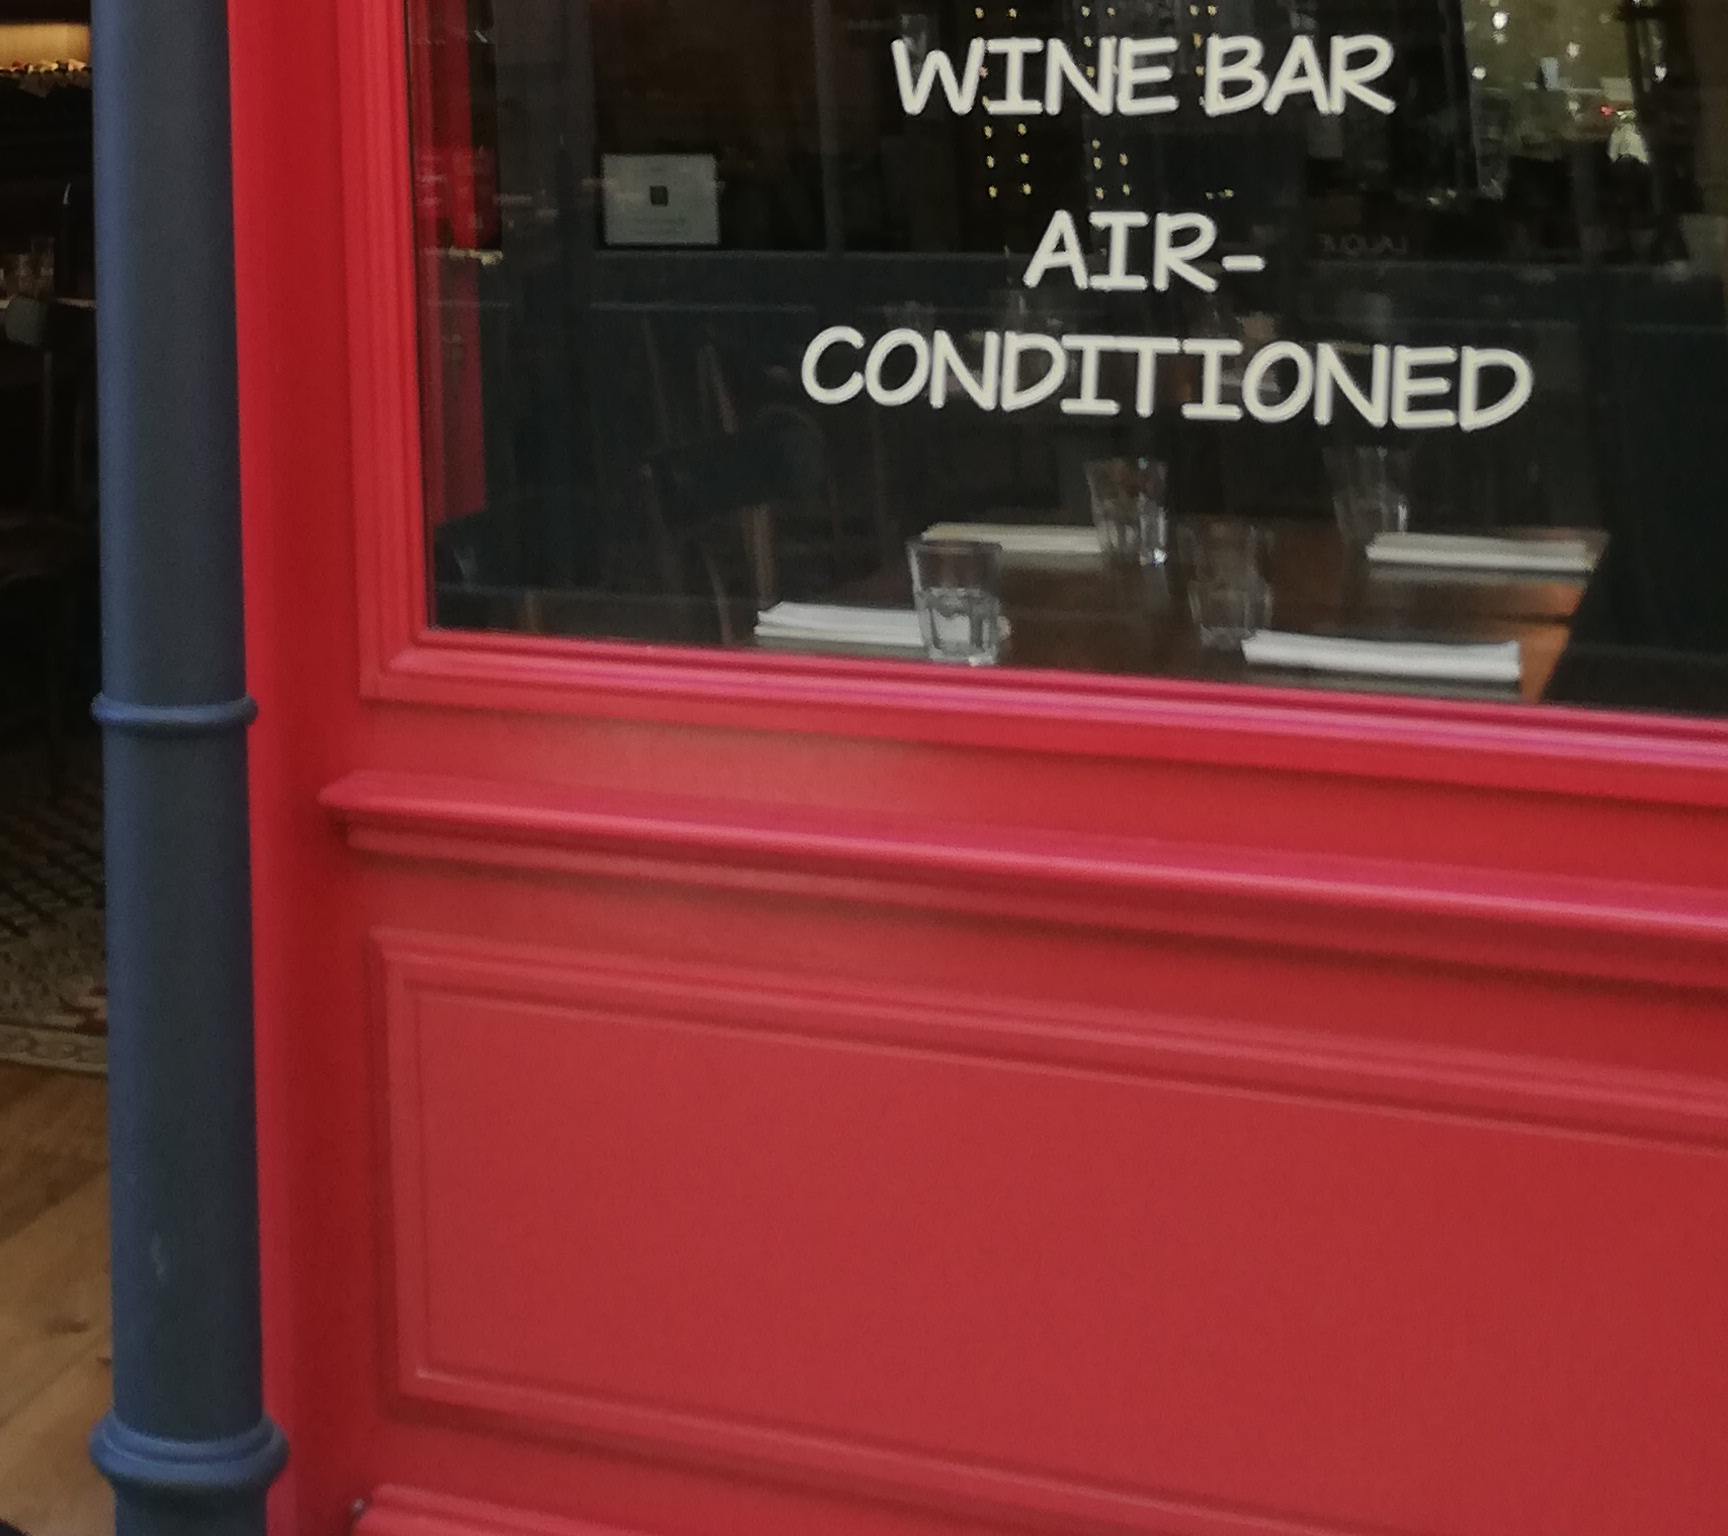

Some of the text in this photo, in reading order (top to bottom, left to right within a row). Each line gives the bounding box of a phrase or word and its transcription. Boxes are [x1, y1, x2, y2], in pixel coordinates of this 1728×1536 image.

[891, 33, 1397, 118] WINE BAR
[1023, 210, 1265, 292] AIR-
[801, 327, 1533, 432] CONDITIONED
